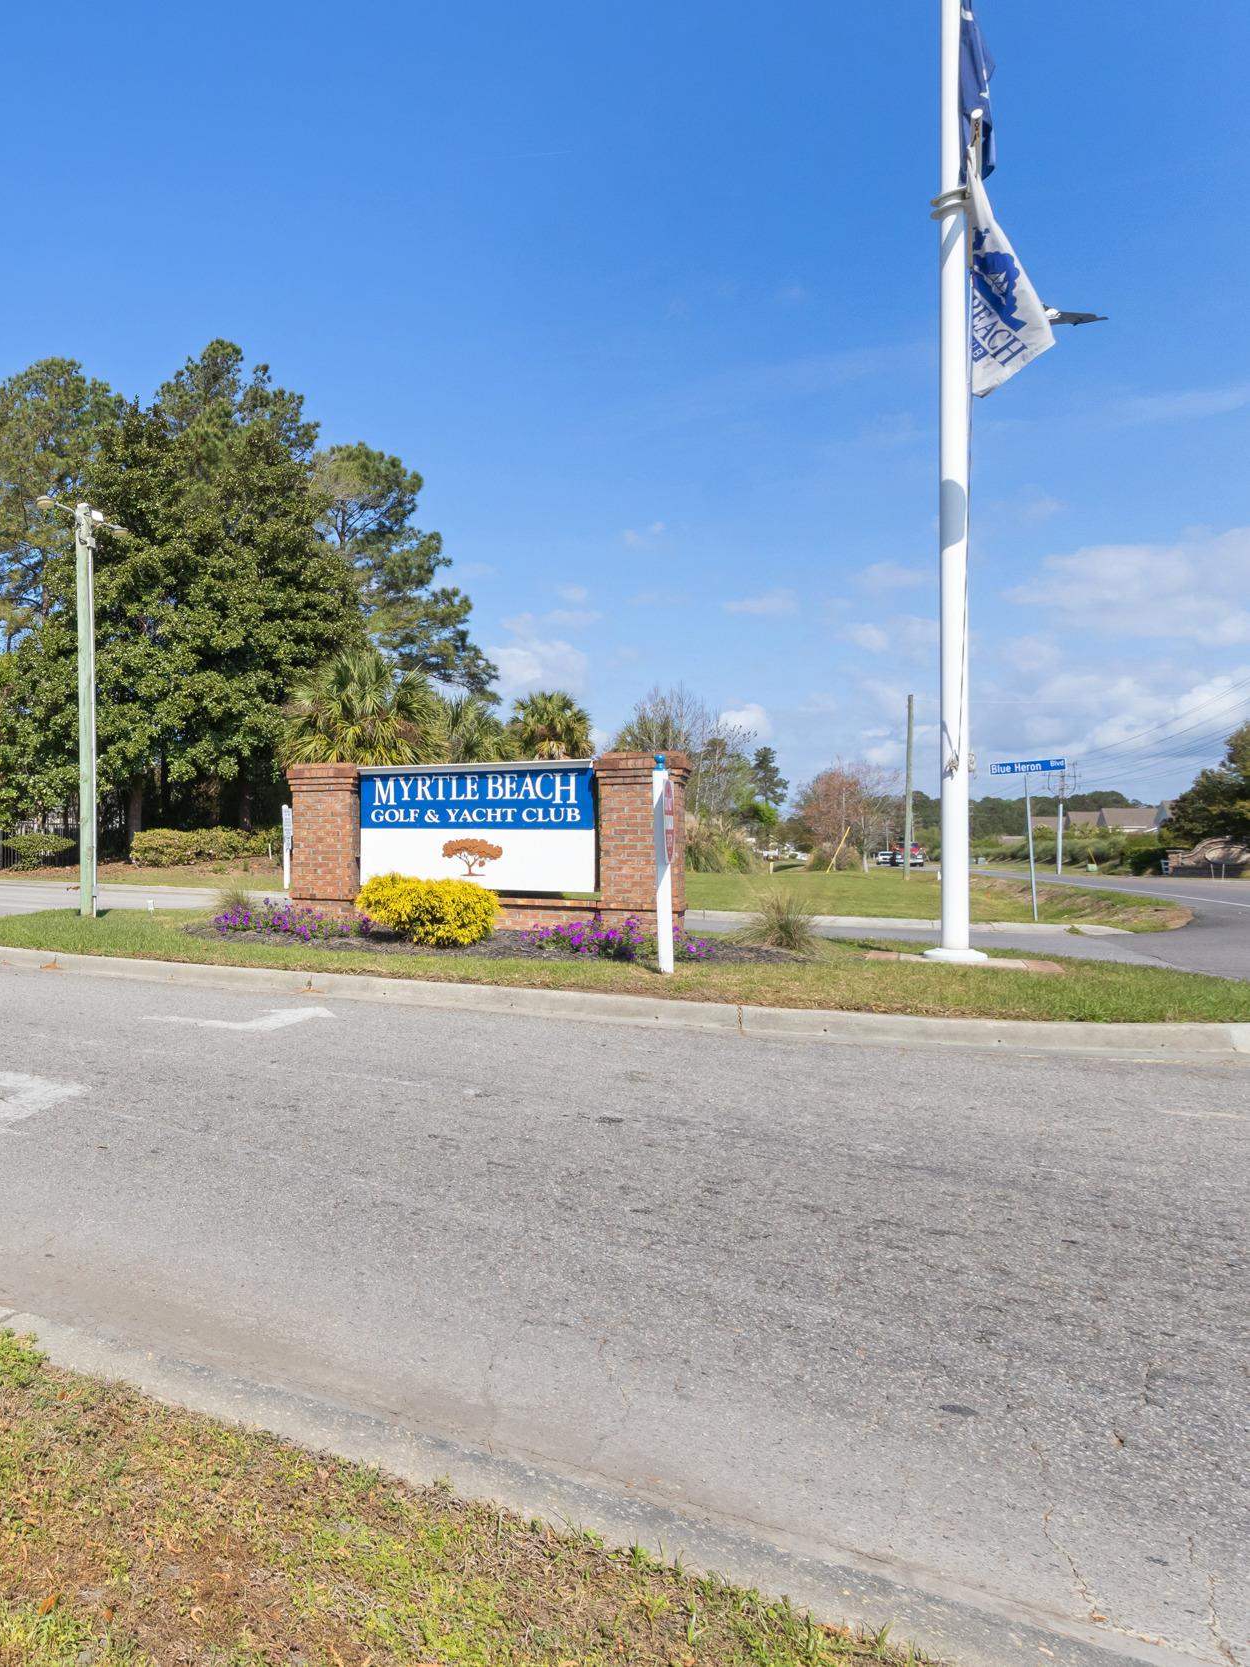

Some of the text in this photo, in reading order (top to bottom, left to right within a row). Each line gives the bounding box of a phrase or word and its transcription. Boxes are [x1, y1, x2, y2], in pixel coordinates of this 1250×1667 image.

[991, 764, 1011, 774] Blue
[1014, 763, 1042, 772] Heron
[372, 773, 579, 806] MYRTLE BEACH
[370, 807, 581, 823] GOLF & YACHT CLUB
